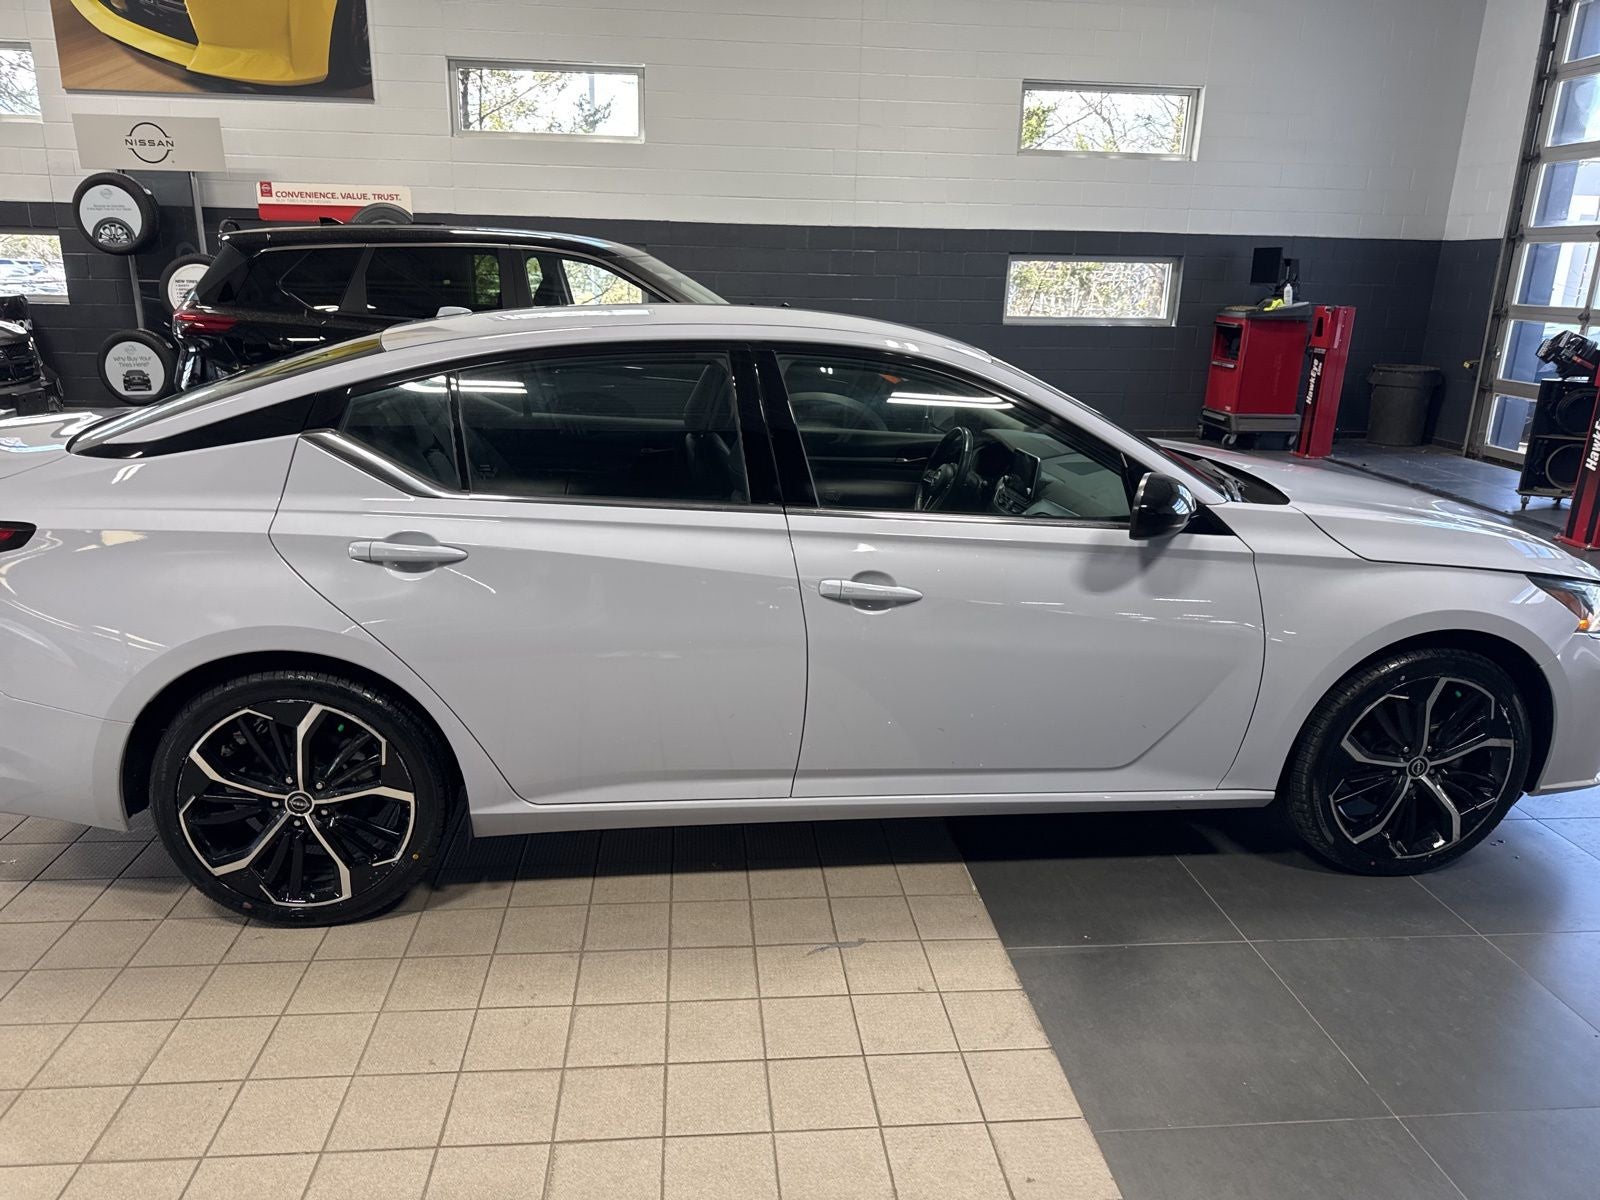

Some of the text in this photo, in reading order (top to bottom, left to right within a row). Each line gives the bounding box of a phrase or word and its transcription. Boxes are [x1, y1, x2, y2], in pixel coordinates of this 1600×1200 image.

[125, 138, 175, 148] NISSAN
[275, 190, 339, 200] CONVENIENCE.
[340, 192, 371, 201] VALUE.
[371, 193, 402, 201] TRUST.
[1305, 358, 1319, 405] HawkEye
